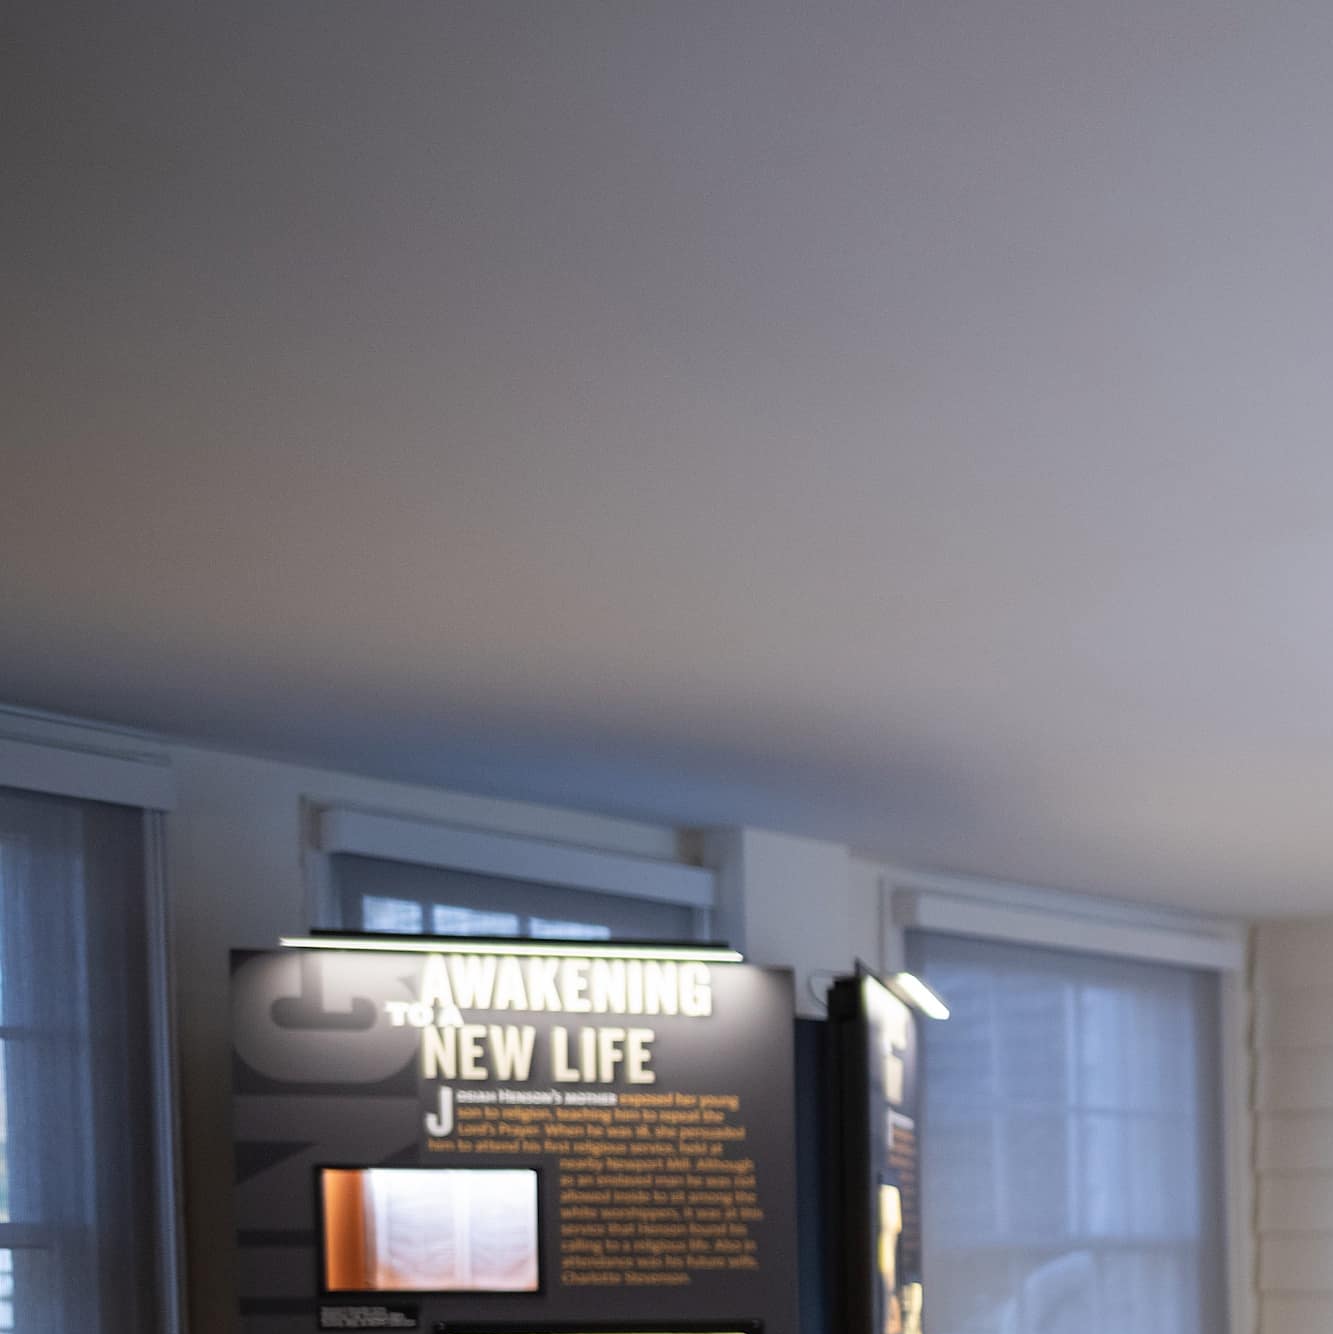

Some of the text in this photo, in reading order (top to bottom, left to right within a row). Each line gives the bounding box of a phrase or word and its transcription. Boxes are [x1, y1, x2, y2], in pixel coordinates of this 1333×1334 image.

[385, 1000, 465, 1028] TO A
[420, 952, 713, 1017] AWAKENING
[422, 1024, 657, 1085] NEW LIFE
